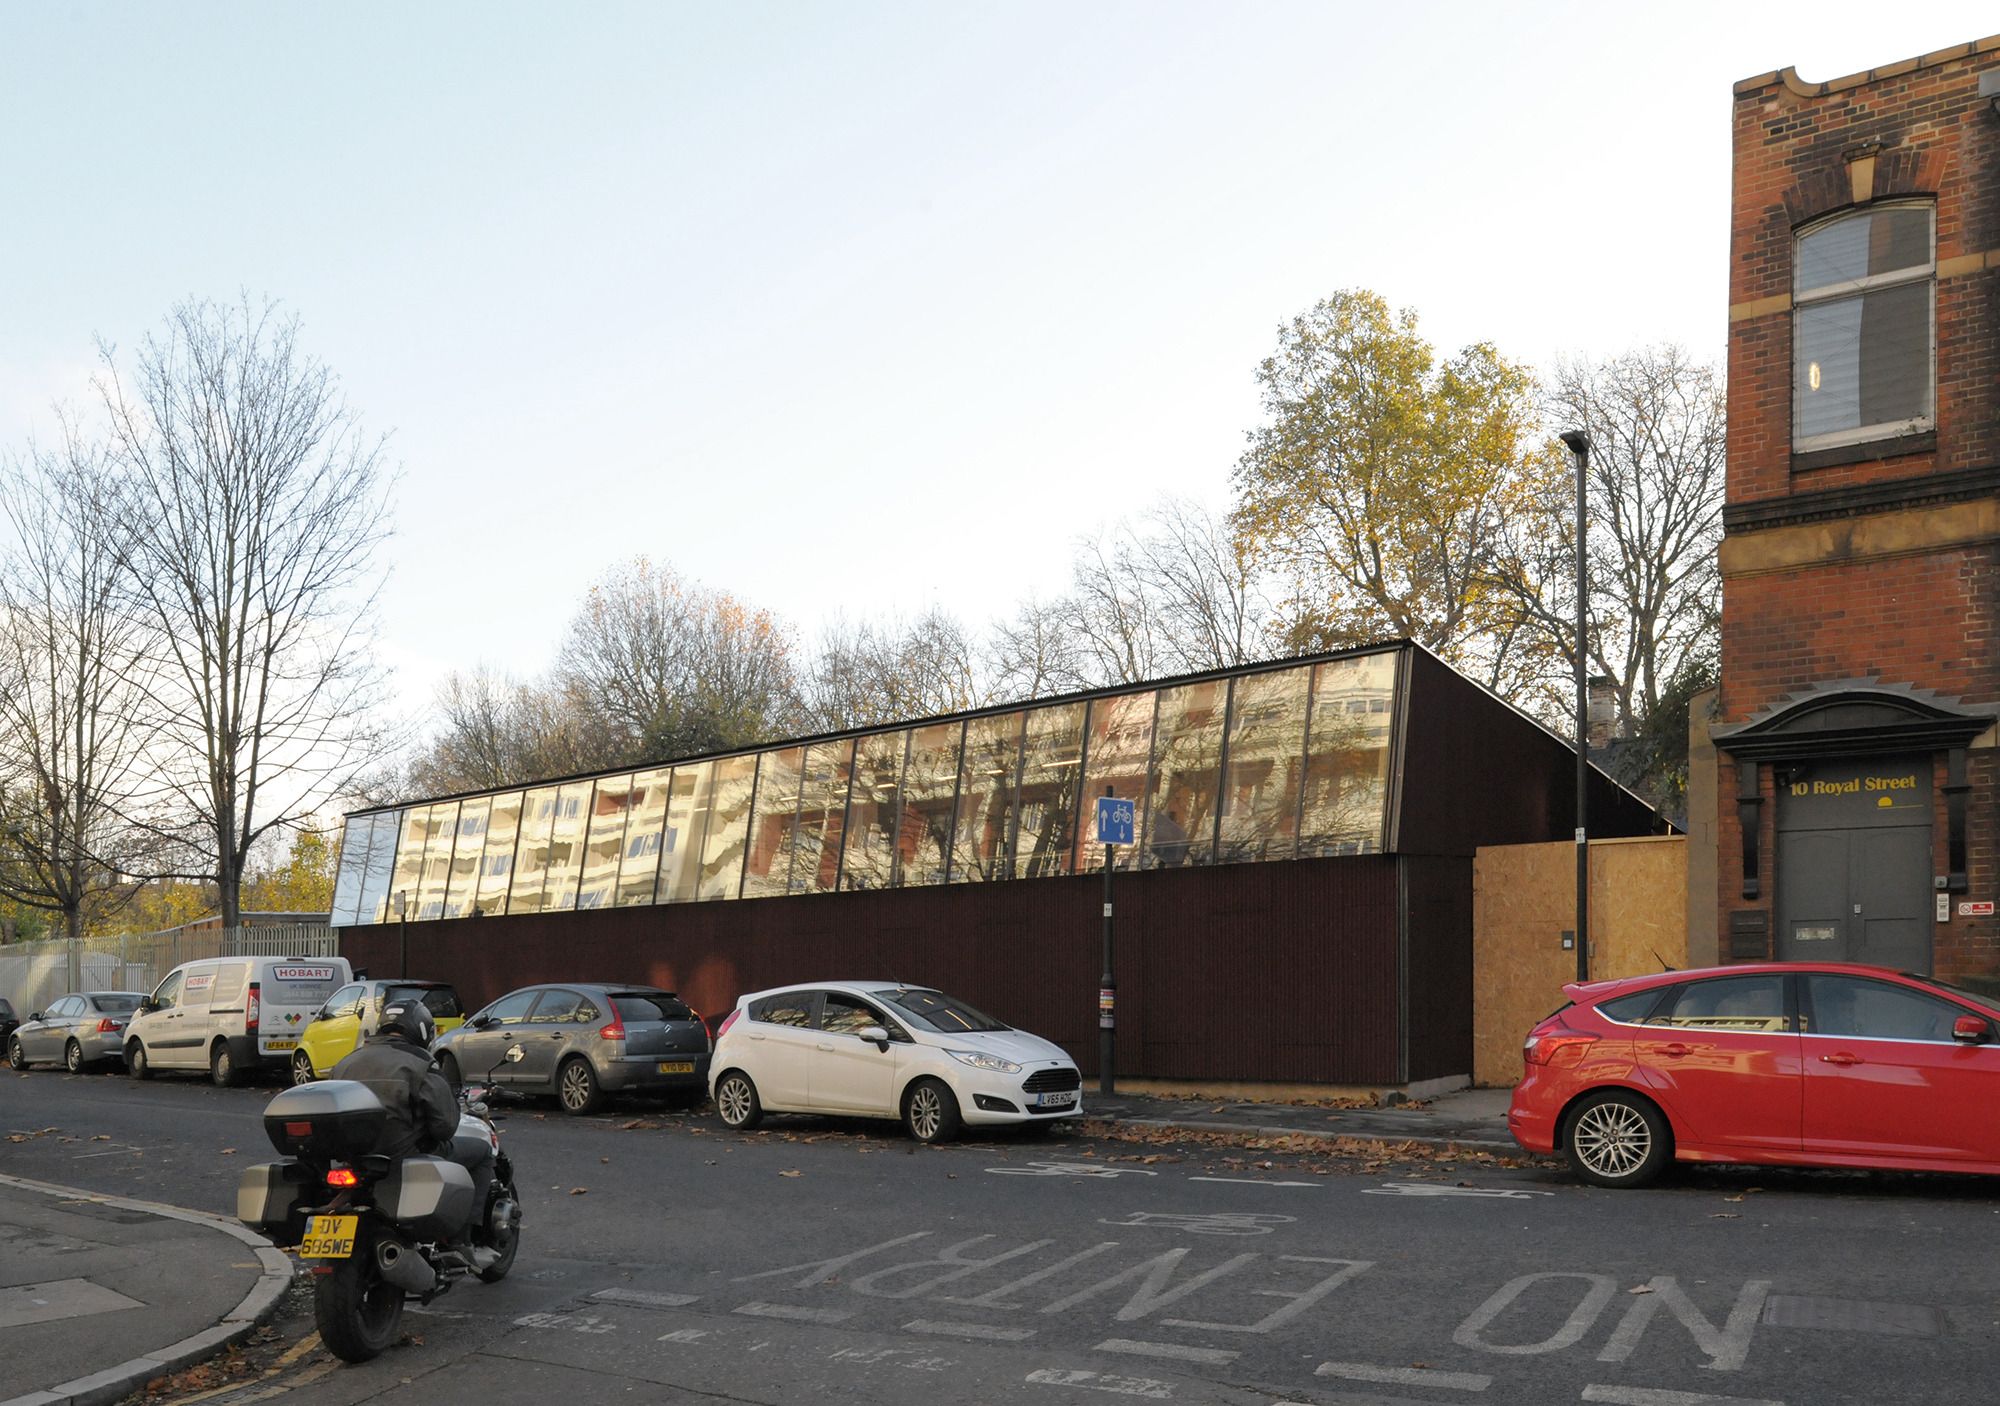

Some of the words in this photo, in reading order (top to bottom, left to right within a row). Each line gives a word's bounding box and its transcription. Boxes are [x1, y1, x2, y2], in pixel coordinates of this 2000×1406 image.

[1792, 782, 1809, 796] 10
[1813, 778, 1860, 796] Royal
[1865, 775, 1917, 791] Street
[279, 969, 330, 977] HOBART
[320, 1219, 343, 1234] DV
[730, 1231, 1378, 1334] ENTRY
[1452, 1272, 1772, 1371] NO
